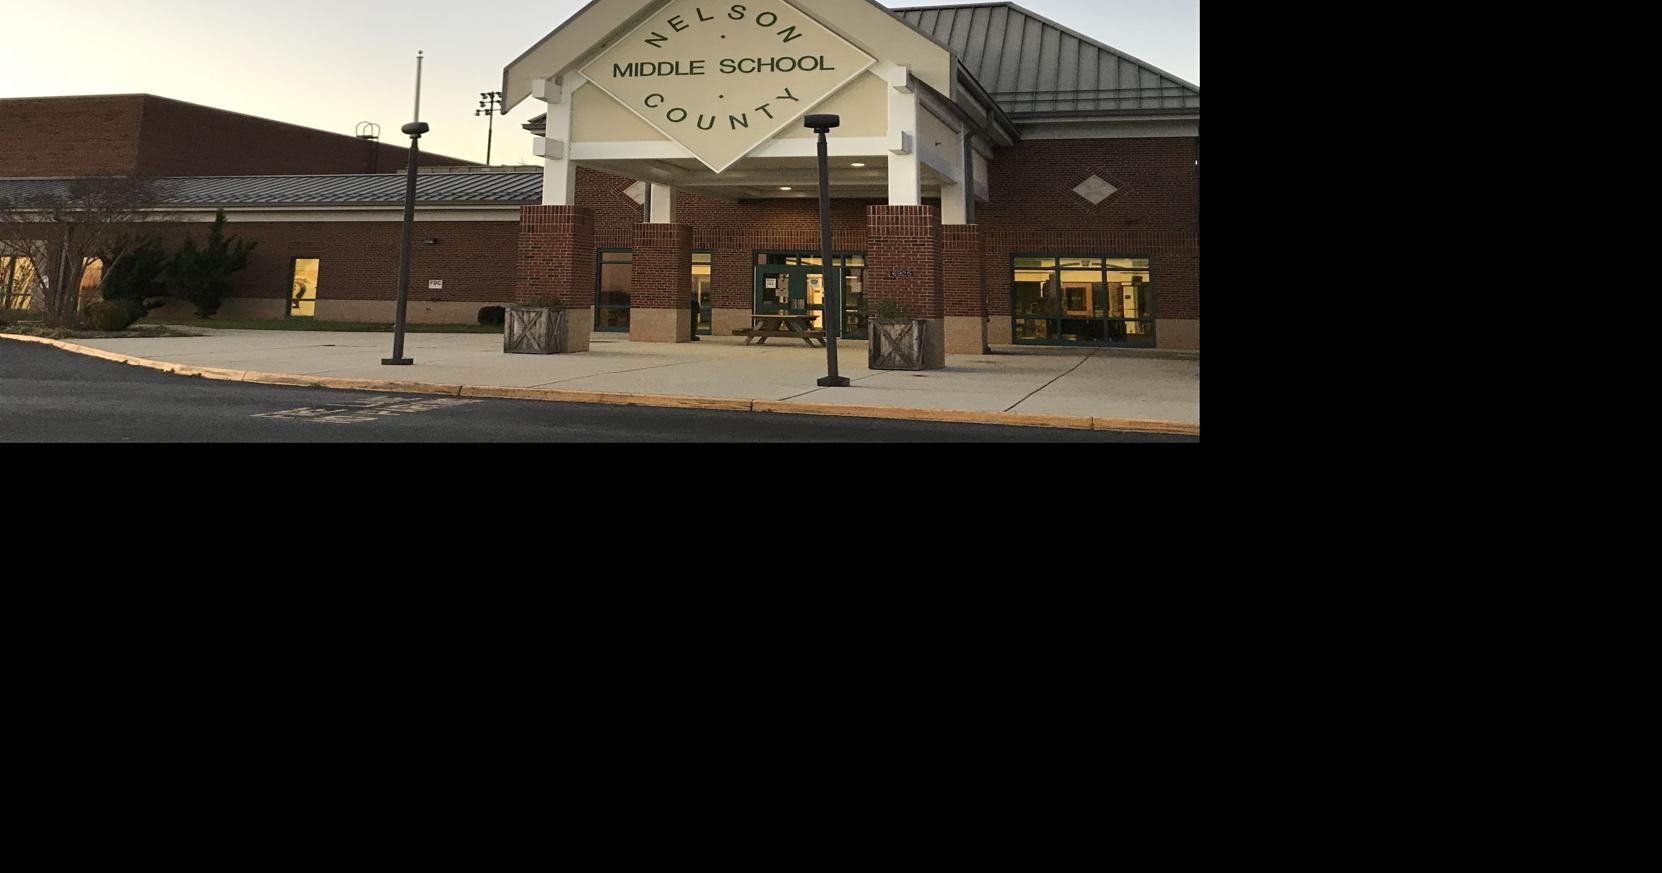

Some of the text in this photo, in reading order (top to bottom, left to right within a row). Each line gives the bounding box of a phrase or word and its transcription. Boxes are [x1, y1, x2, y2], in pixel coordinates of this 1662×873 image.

[644, 4, 803, 49] NELSON
[612, 55, 836, 78] MIDDLE SCHOOL
[644, 87, 799, 131] COUNTY
